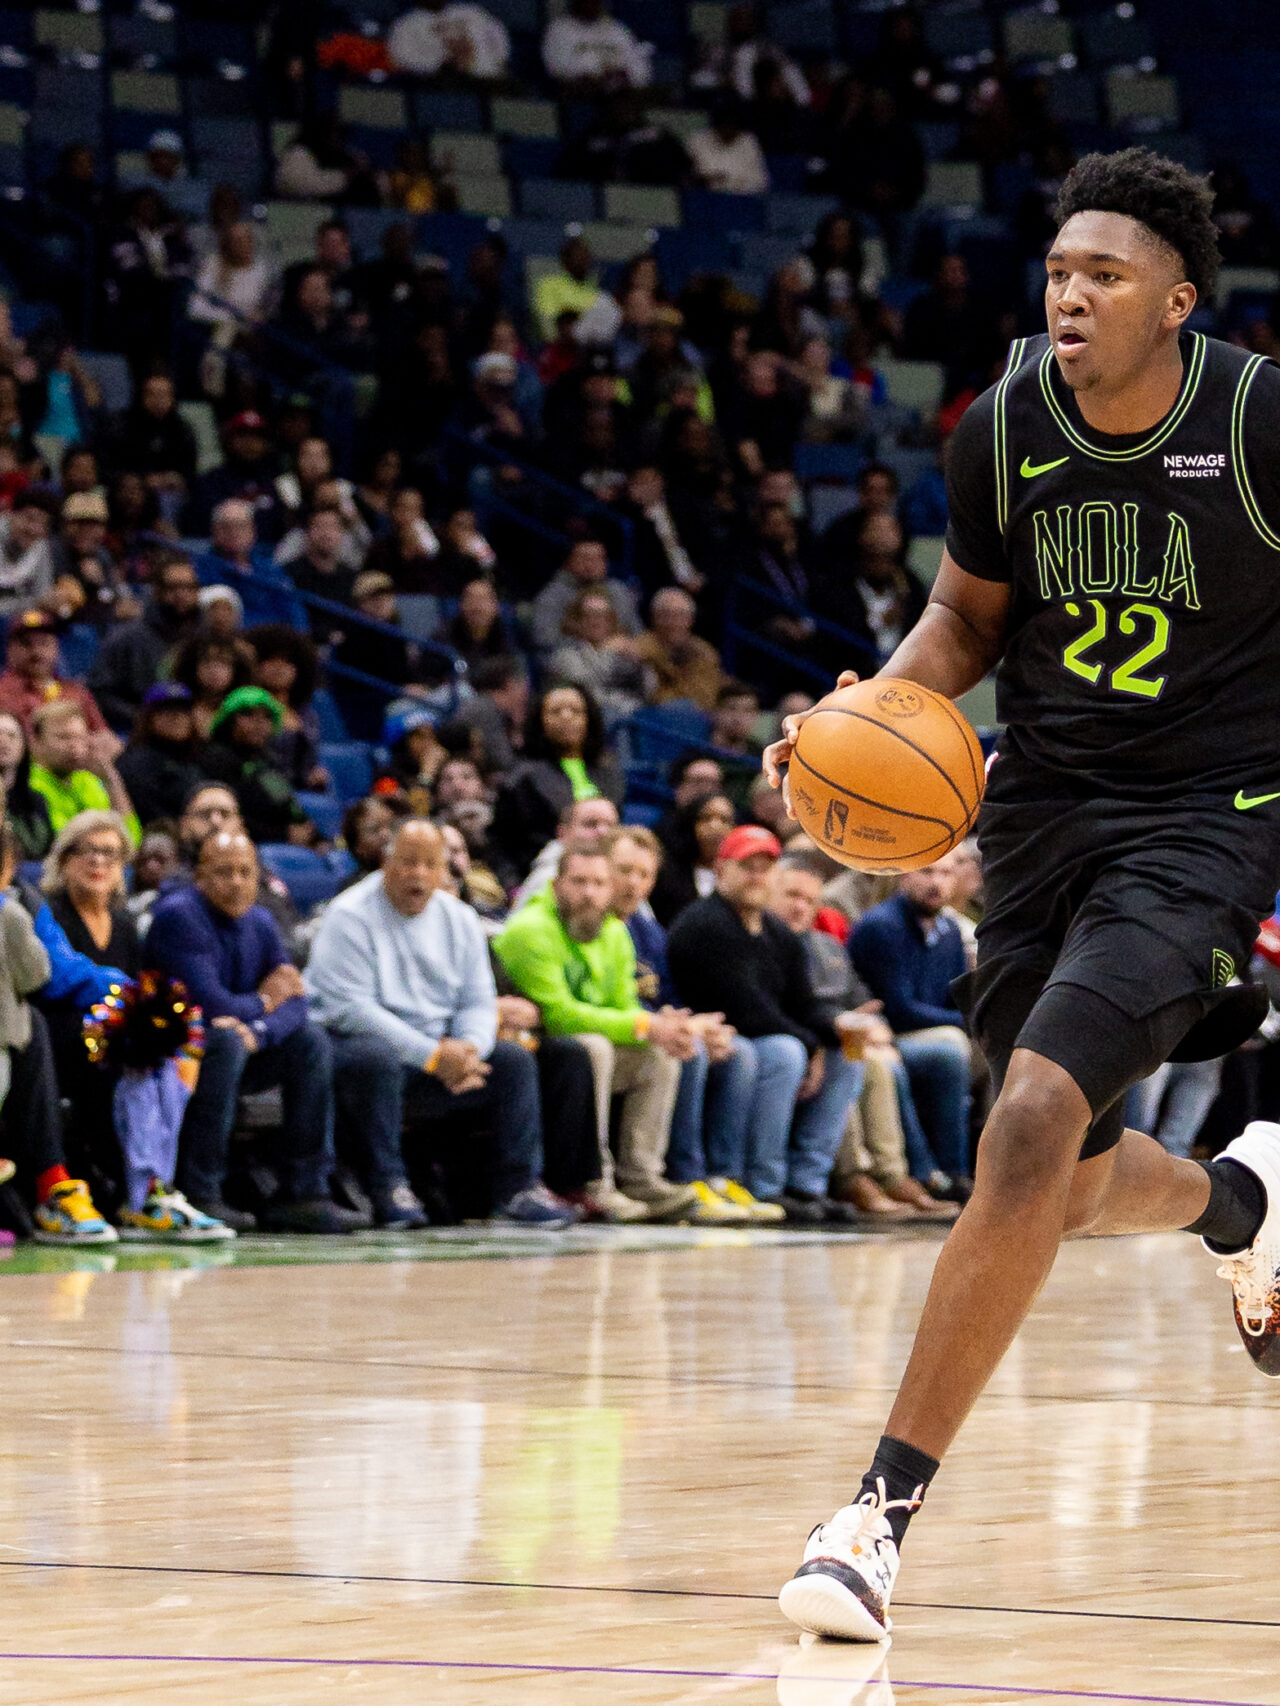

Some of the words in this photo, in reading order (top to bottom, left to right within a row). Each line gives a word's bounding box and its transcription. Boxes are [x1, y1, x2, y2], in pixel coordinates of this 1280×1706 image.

[1163, 454, 1226, 468] NEWAGE
[1169, 469, 1220, 478] PRODUCTS
[1033, 501, 1201, 610] NOLA
[1062, 600, 1171, 699] 22
